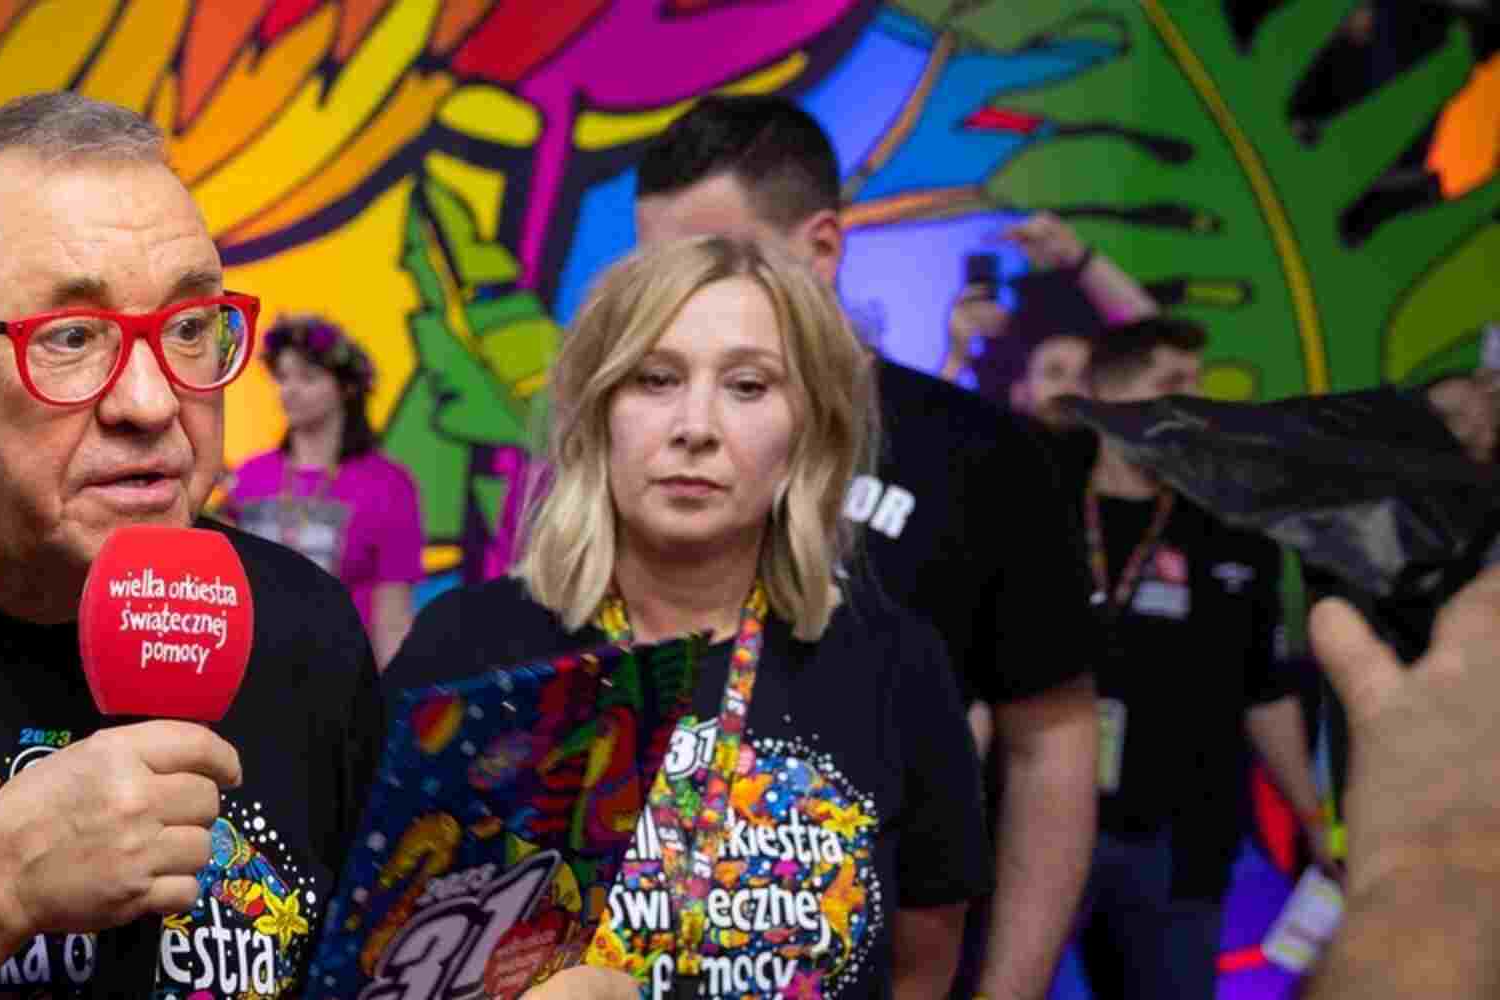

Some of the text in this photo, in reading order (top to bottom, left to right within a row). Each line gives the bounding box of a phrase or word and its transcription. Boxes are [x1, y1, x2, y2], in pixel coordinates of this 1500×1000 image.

[109, 567, 238, 606] wielka orkiestra
[119, 600, 228, 649] świątecznej
[140, 640, 211, 674] pomocy
